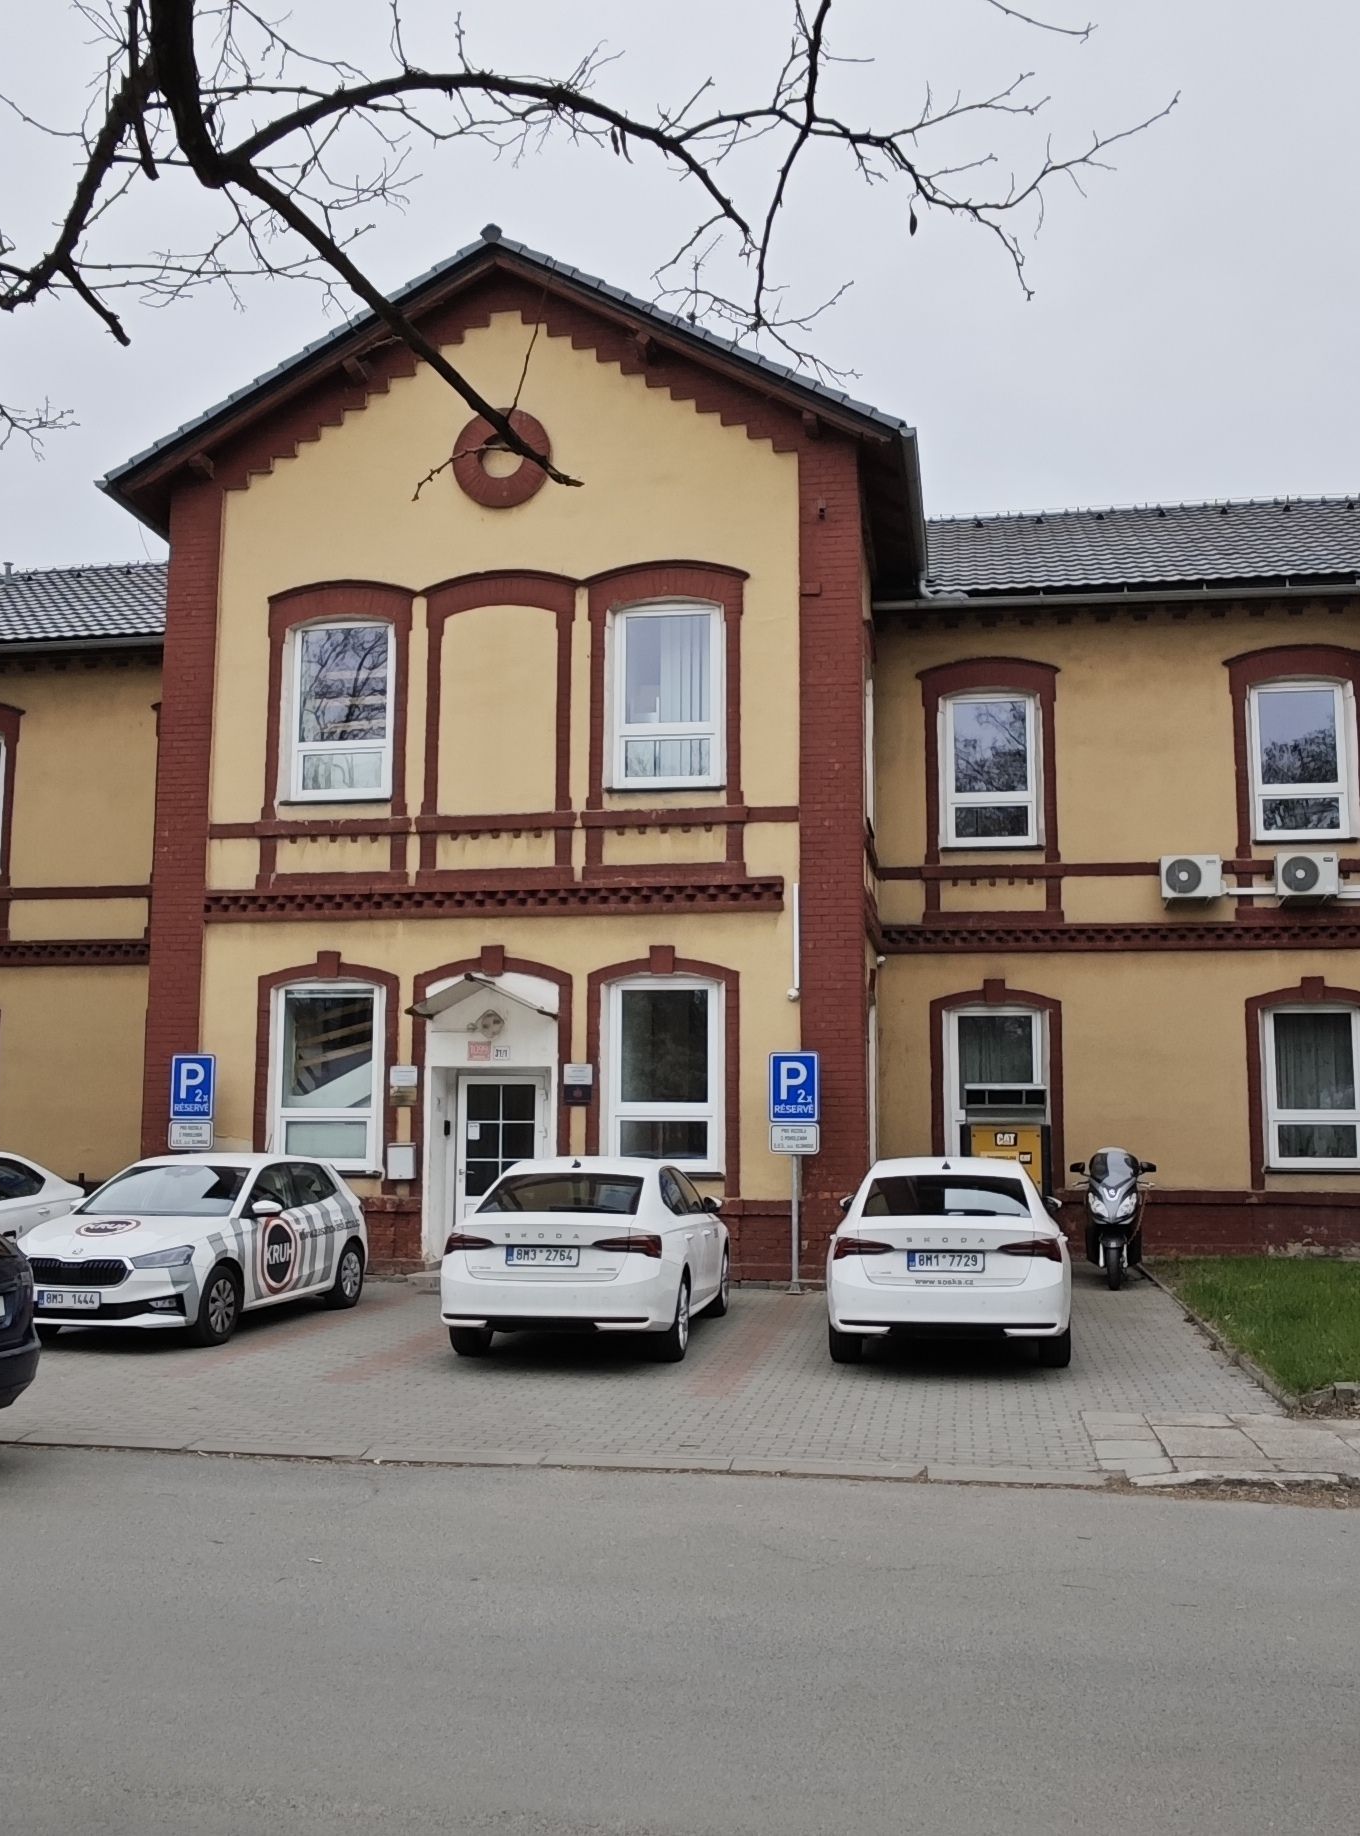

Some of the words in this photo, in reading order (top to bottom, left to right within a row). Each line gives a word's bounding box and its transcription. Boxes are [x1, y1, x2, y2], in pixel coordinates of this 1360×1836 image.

[180, 1063, 205, 1099] P
[780, 1061, 807, 1100] P
[194, 1089, 208, 1102] 2x
[797, 1089, 812, 1103] 2x
[774, 1103, 814, 1114] RÉSERVÉ
[996, 1133, 1016, 1146] CAT
[267, 1242, 292, 1264] KRUH
[516, 1249, 537, 1261] 8M3
[545, 1249, 573, 1261] 2764
[918, 1254, 940, 1266] 8M1
[949, 1254, 978, 1266] 7729
[46, 1293, 64, 1304] 8M3
[72, 1294, 95, 1305] 1444
